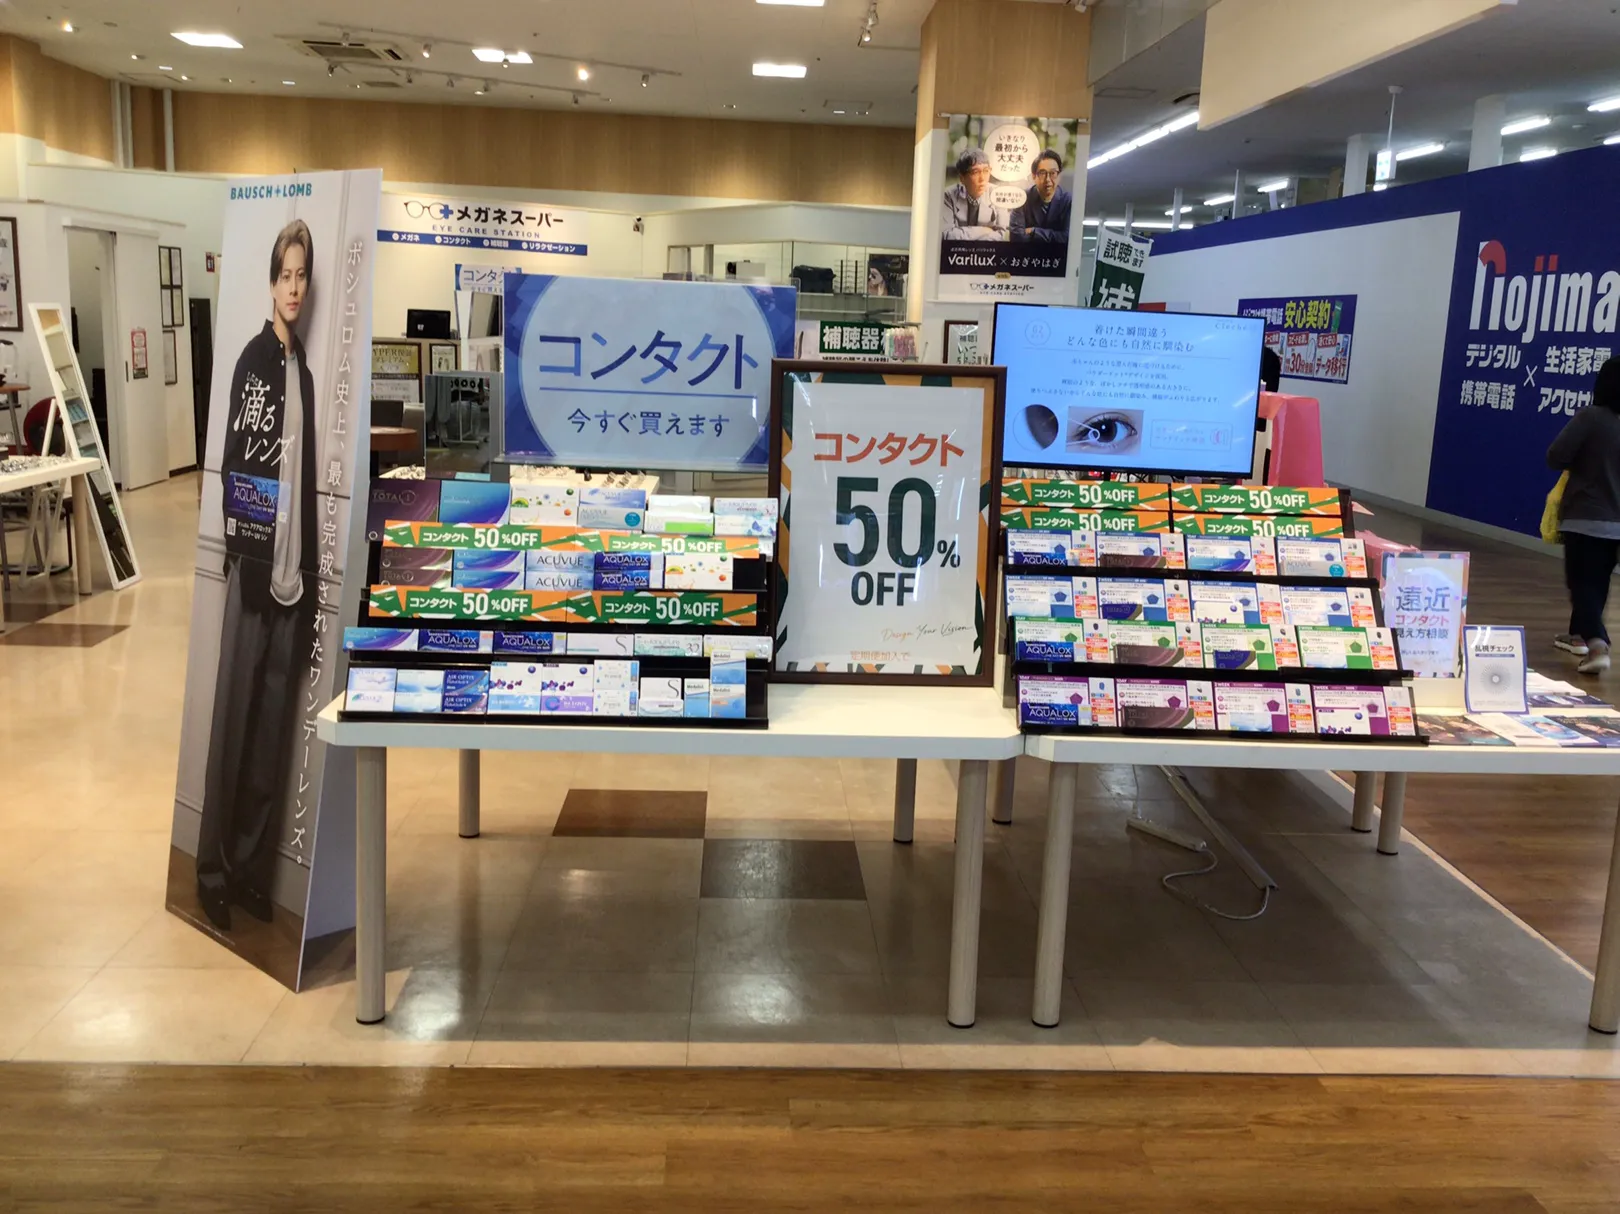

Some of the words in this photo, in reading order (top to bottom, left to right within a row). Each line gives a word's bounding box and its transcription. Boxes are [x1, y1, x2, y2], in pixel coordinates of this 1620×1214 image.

[998, 134, 1026, 142] いきなり
[995, 143, 1028, 152] 最初から
[997, 154, 1024, 163] 大丈夫
[1000, 164, 1020, 173] だった
[230, 182, 313, 200] BAUSCH+LOMB
[456, 206, 564, 228] メガネスーパー
[432, 224, 453, 232] EYE
[459, 226, 488, 235] CARE
[493, 229, 541, 239] STATION
[400, 234, 420, 242] メガネ
[443, 236, 471, 246] コンタクト
[529, 242, 576, 253] リラクゼーション
[1103, 238, 1133, 264] 試聴
[1010, 257, 1060, 268] おぎやはぎ
[990, 283, 1034, 292] メガネスーパー
[1469, 240, 1620, 344] nojima
[1284, 300, 1331, 330] 安心契約
[1095, 324, 1167, 338] 着けた瞬間違う
[822, 326, 887, 350] 補聴器
[1067, 336, 1194, 352] どんな色にも自然に馴染む
[539, 330, 759, 390] コンタクト
[1466, 344, 1522, 370] デジタル
[1544, 346, 1612, 376] 生活家電
[1460, 380, 1516, 411] 携帯電話
[1538, 386, 1596, 416] アクセサ
[233, 380, 277, 432] 滴る
[567, 408, 730, 438] 今すぐ買えます
[244, 434, 296, 468] レンズ
[814, 432, 965, 467] コンタクト
[233, 486, 277, 508] AQUALOX
[1034, 489, 1074, 498] コンタクト
[1204, 494, 1244, 504] コンタクト
[1034, 518, 1074, 526] コンタクト
[1207, 524, 1248, 533] コンタクト
[422, 532, 470, 543] コンタクト
[612, 541, 656, 550] コンタクト
[291, 241, 363, 865] ボシュロム史上、最も完成されたワンデーレンズ。
[536, 555, 584, 566] ACUVUE
[602, 555, 648, 566] AQUALOX
[1023, 557, 1066, 566] AQUALOX
[536, 576, 582, 588] ACUVUE
[602, 576, 648, 585] AQUALOX
[850, 572, 916, 606] OFF
[410, 597, 458, 609] コンタクト
[1396, 586, 1450, 612] 遠近
[604, 602, 650, 614] コンタクト
[1396, 615, 1450, 627] コンタクト
[881, 628, 914, 643] Design
[917, 624, 938, 640] Your
[940, 620, 974, 637] Vision
[1396, 628, 1449, 639] 見え方相談
[428, 636, 478, 645] AQUALOX
[502, 636, 551, 646] AQUALOX
[1474, 644, 1515, 653] 乱視チェック
[850, 650, 911, 662] 定期便加入で
[1029, 710, 1076, 718] AQUALOX
